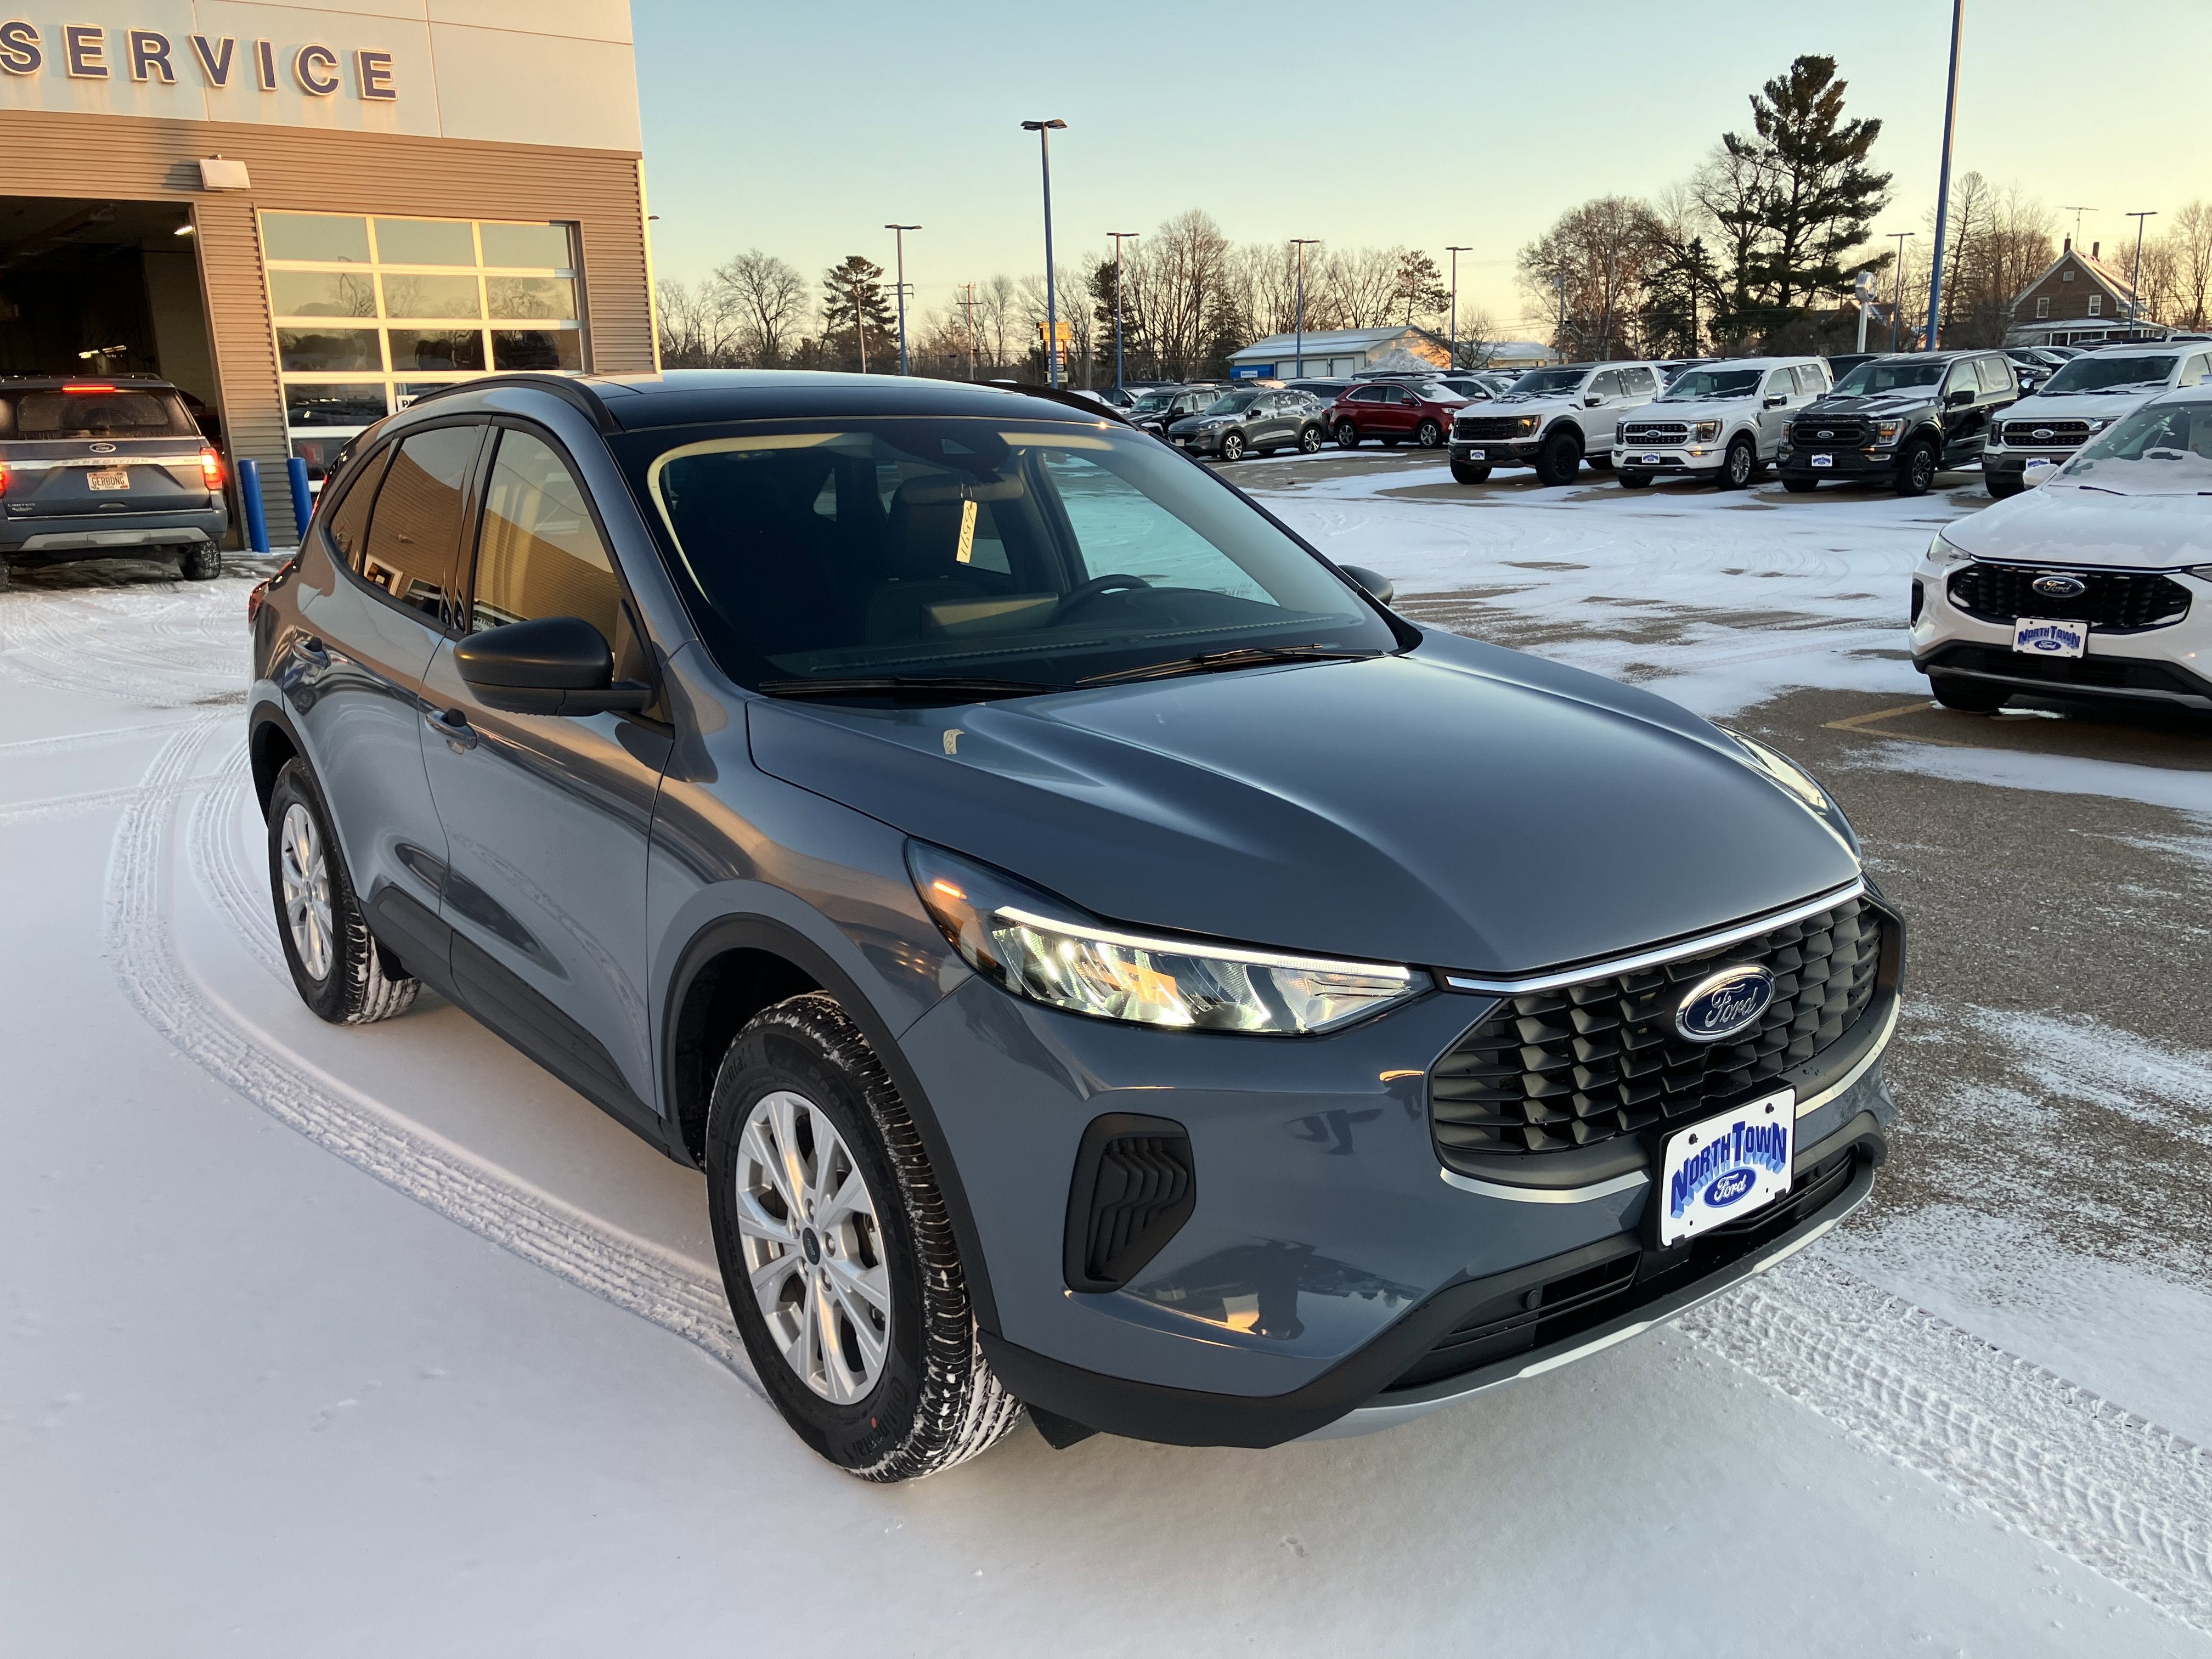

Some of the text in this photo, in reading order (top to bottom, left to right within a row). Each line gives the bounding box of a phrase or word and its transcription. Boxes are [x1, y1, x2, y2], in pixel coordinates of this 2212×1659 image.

[0, 20, 398, 101] SERVICE
[2043, 580, 2072, 593] Ford
[2017, 625, 2081, 650] NORTH TOWN
[2039, 641, 2057, 649] Ford
[1705, 983, 1758, 1028] Ford
[1671, 1121, 1787, 1218] NORTH TOWN
[1713, 1172, 1747, 1203] Ford
